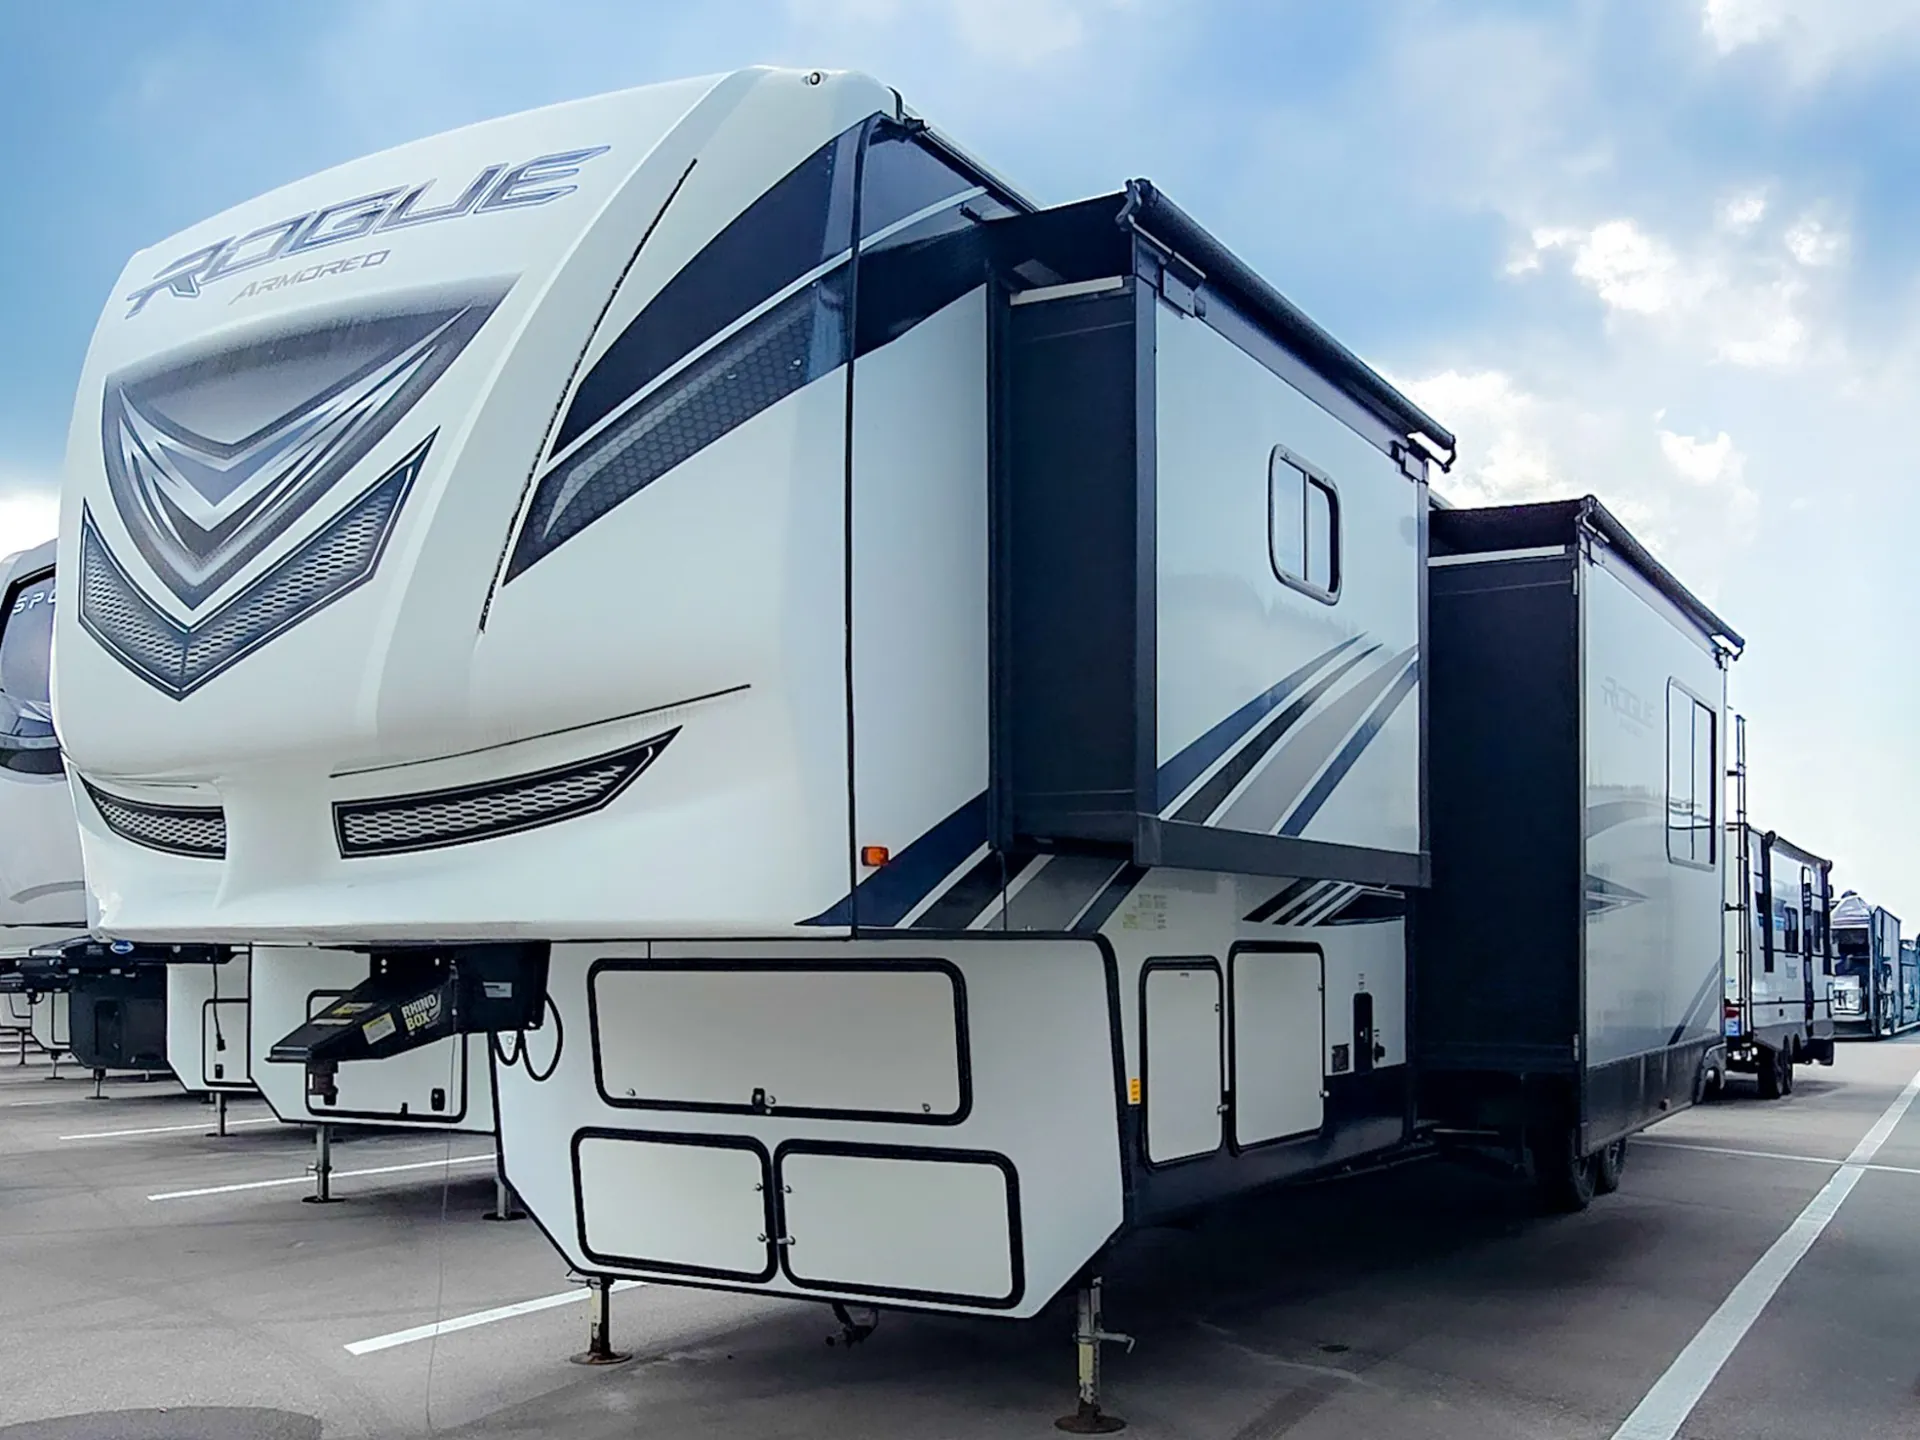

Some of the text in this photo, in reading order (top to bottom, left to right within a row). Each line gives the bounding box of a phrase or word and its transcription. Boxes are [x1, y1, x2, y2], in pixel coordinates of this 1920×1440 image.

[125, 145, 611, 320] ROGUE
[227, 249, 391, 306] ARMORED
[401, 994, 437, 1018] RHINO
[405, 1010, 431, 1031] BOX
